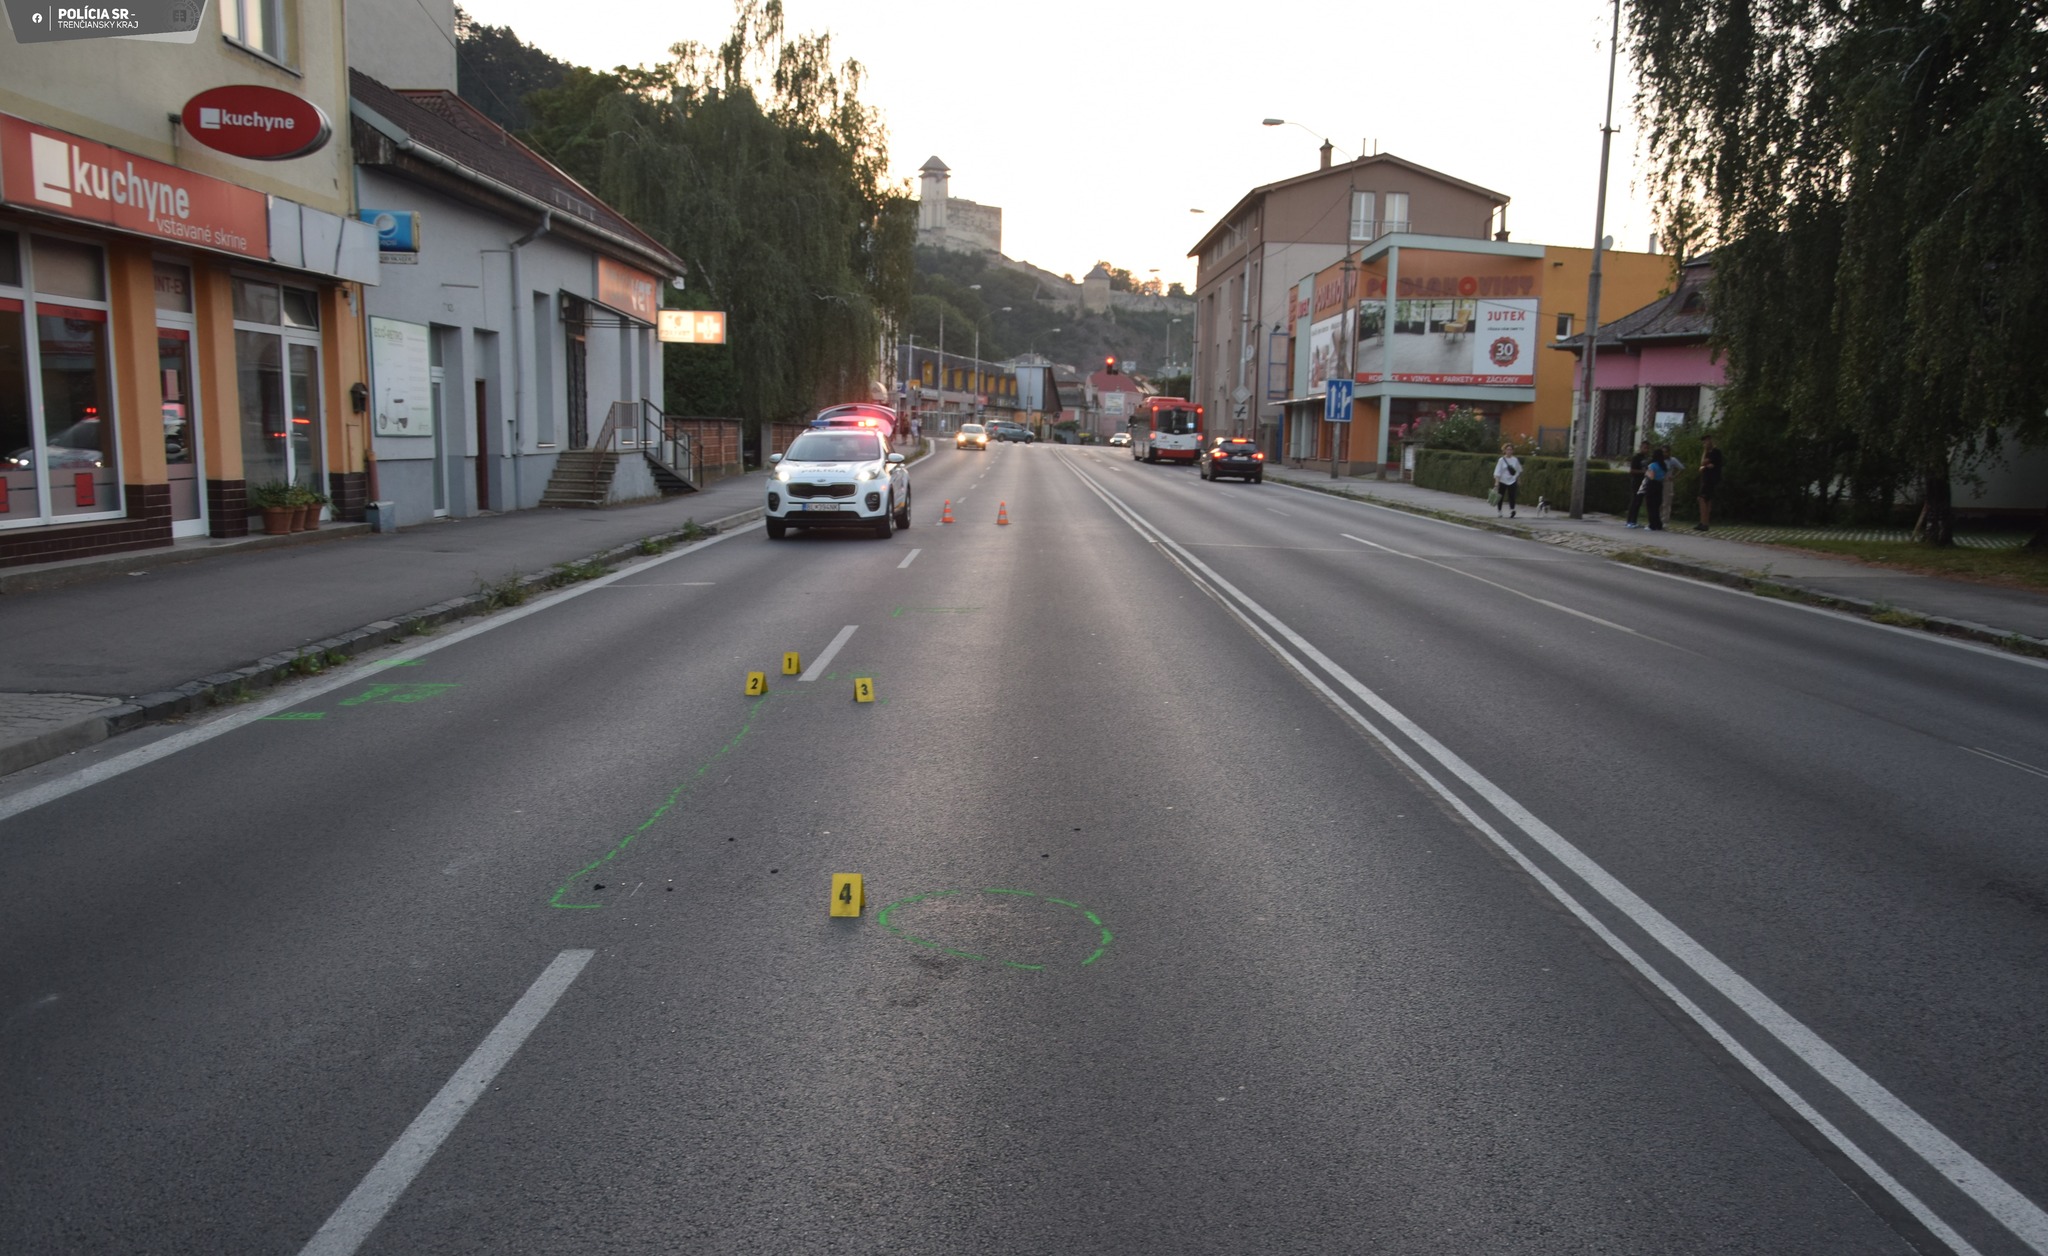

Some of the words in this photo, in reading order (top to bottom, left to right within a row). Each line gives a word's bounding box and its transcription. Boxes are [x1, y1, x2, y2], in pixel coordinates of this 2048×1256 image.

[221, 109, 295, 132] kuchyne
[72, 144, 190, 222] kuchyne
[156, 216, 212, 243] vstavané
[214, 229, 247, 251] skrine
[1487, 310, 1526, 322] JUTEX
[1495, 343, 1514, 356] 30
[1410, 375, 1432, 383] VINYL
[1442, 375, 1474, 383] PARKETY
[787, 657, 792, 669] 1
[750, 677, 758, 690] 2
[861, 683, 868, 696] 3
[838, 882, 852, 905] 4
